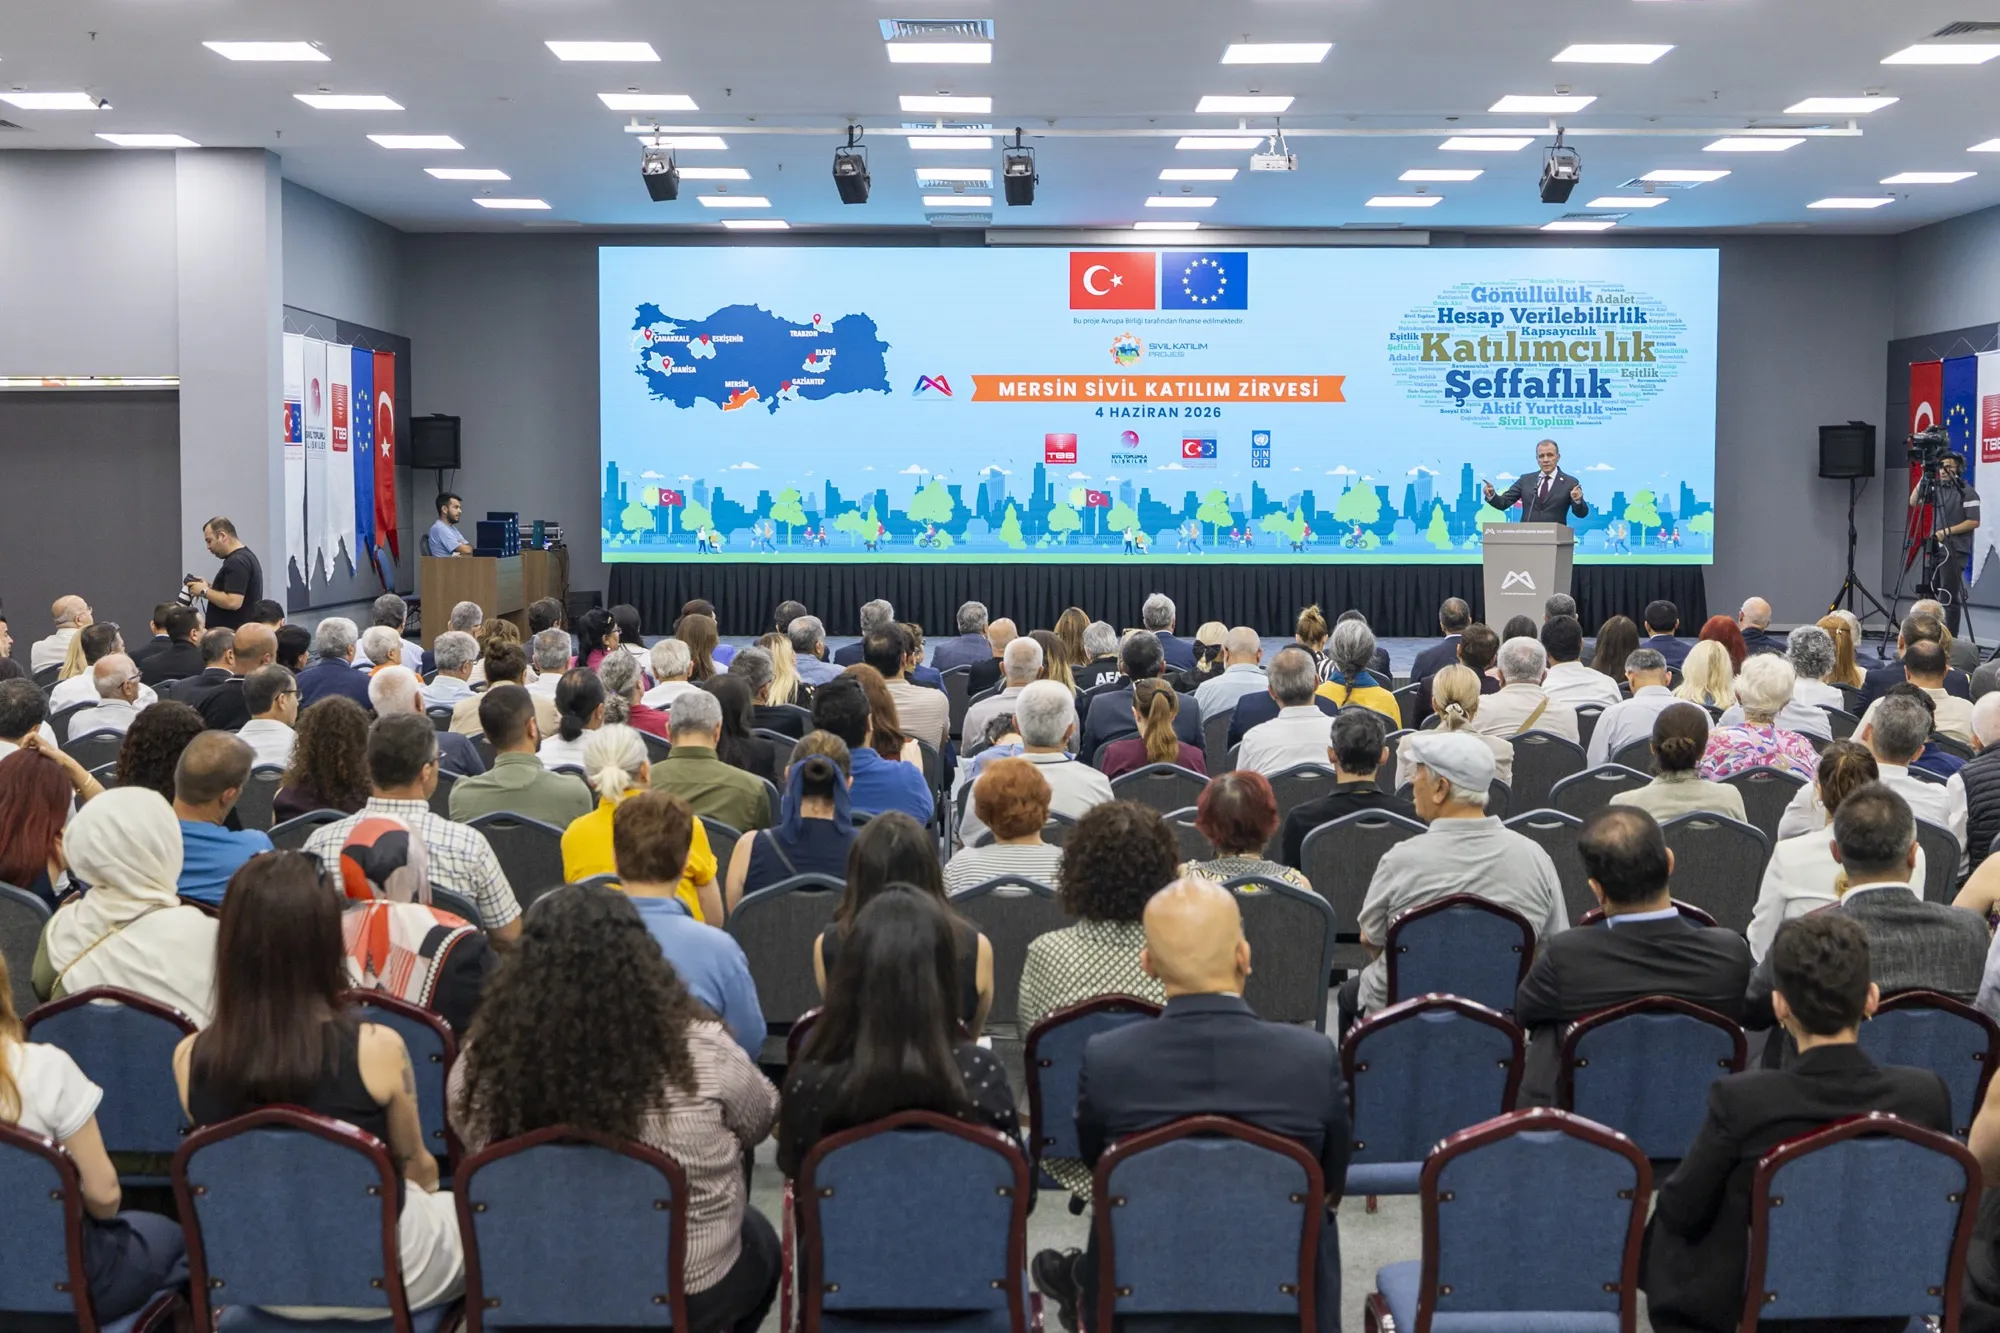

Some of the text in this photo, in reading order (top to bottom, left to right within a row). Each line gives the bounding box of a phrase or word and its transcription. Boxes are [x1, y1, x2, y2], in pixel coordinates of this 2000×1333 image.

[1471, 286, 1593, 303] Gönüllülük
[1594, 294, 1636, 304] Adalet
[1083, 317, 1100, 326] proje
[1101, 317, 1124, 326] Avrupa
[1125, 317, 1144, 326] Birliği
[1437, 306, 1648, 328] Hesap Verilebilirlik
[789, 330, 819, 338] TRABZON
[1389, 332, 1420, 342] Eşitlik
[1521, 325, 1597, 339] Kapsayıcılık
[654, 335, 690, 343] ÇANAKKALE
[712, 334, 744, 344] ESKİŞEHİR
[1172, 342, 1208, 350] KATILIM
[1387, 343, 1421, 352] Şeffaflık
[1420, 330, 1657, 363] Katılımcılık
[815, 347, 837, 356] ELAZIĞ
[1388, 353, 1420, 361] Adalet
[671, 365, 697, 373] MANİSA
[1621, 368, 1660, 380] Eşitlik
[724, 379, 749, 388] MERSİN
[791, 377, 826, 386] GAZİANTEP
[998, 378, 1319, 398] MERSİN SİVİL KATILIM ZİRVESİ
[1444, 367, 1613, 408] Şeffaflık
[1095, 404, 1222, 418] 4 HAZİRAN 2026
[1480, 401, 1604, 418] Aktif Yurttaşlık
[1498, 415, 1575, 428] Sivil Toplum
